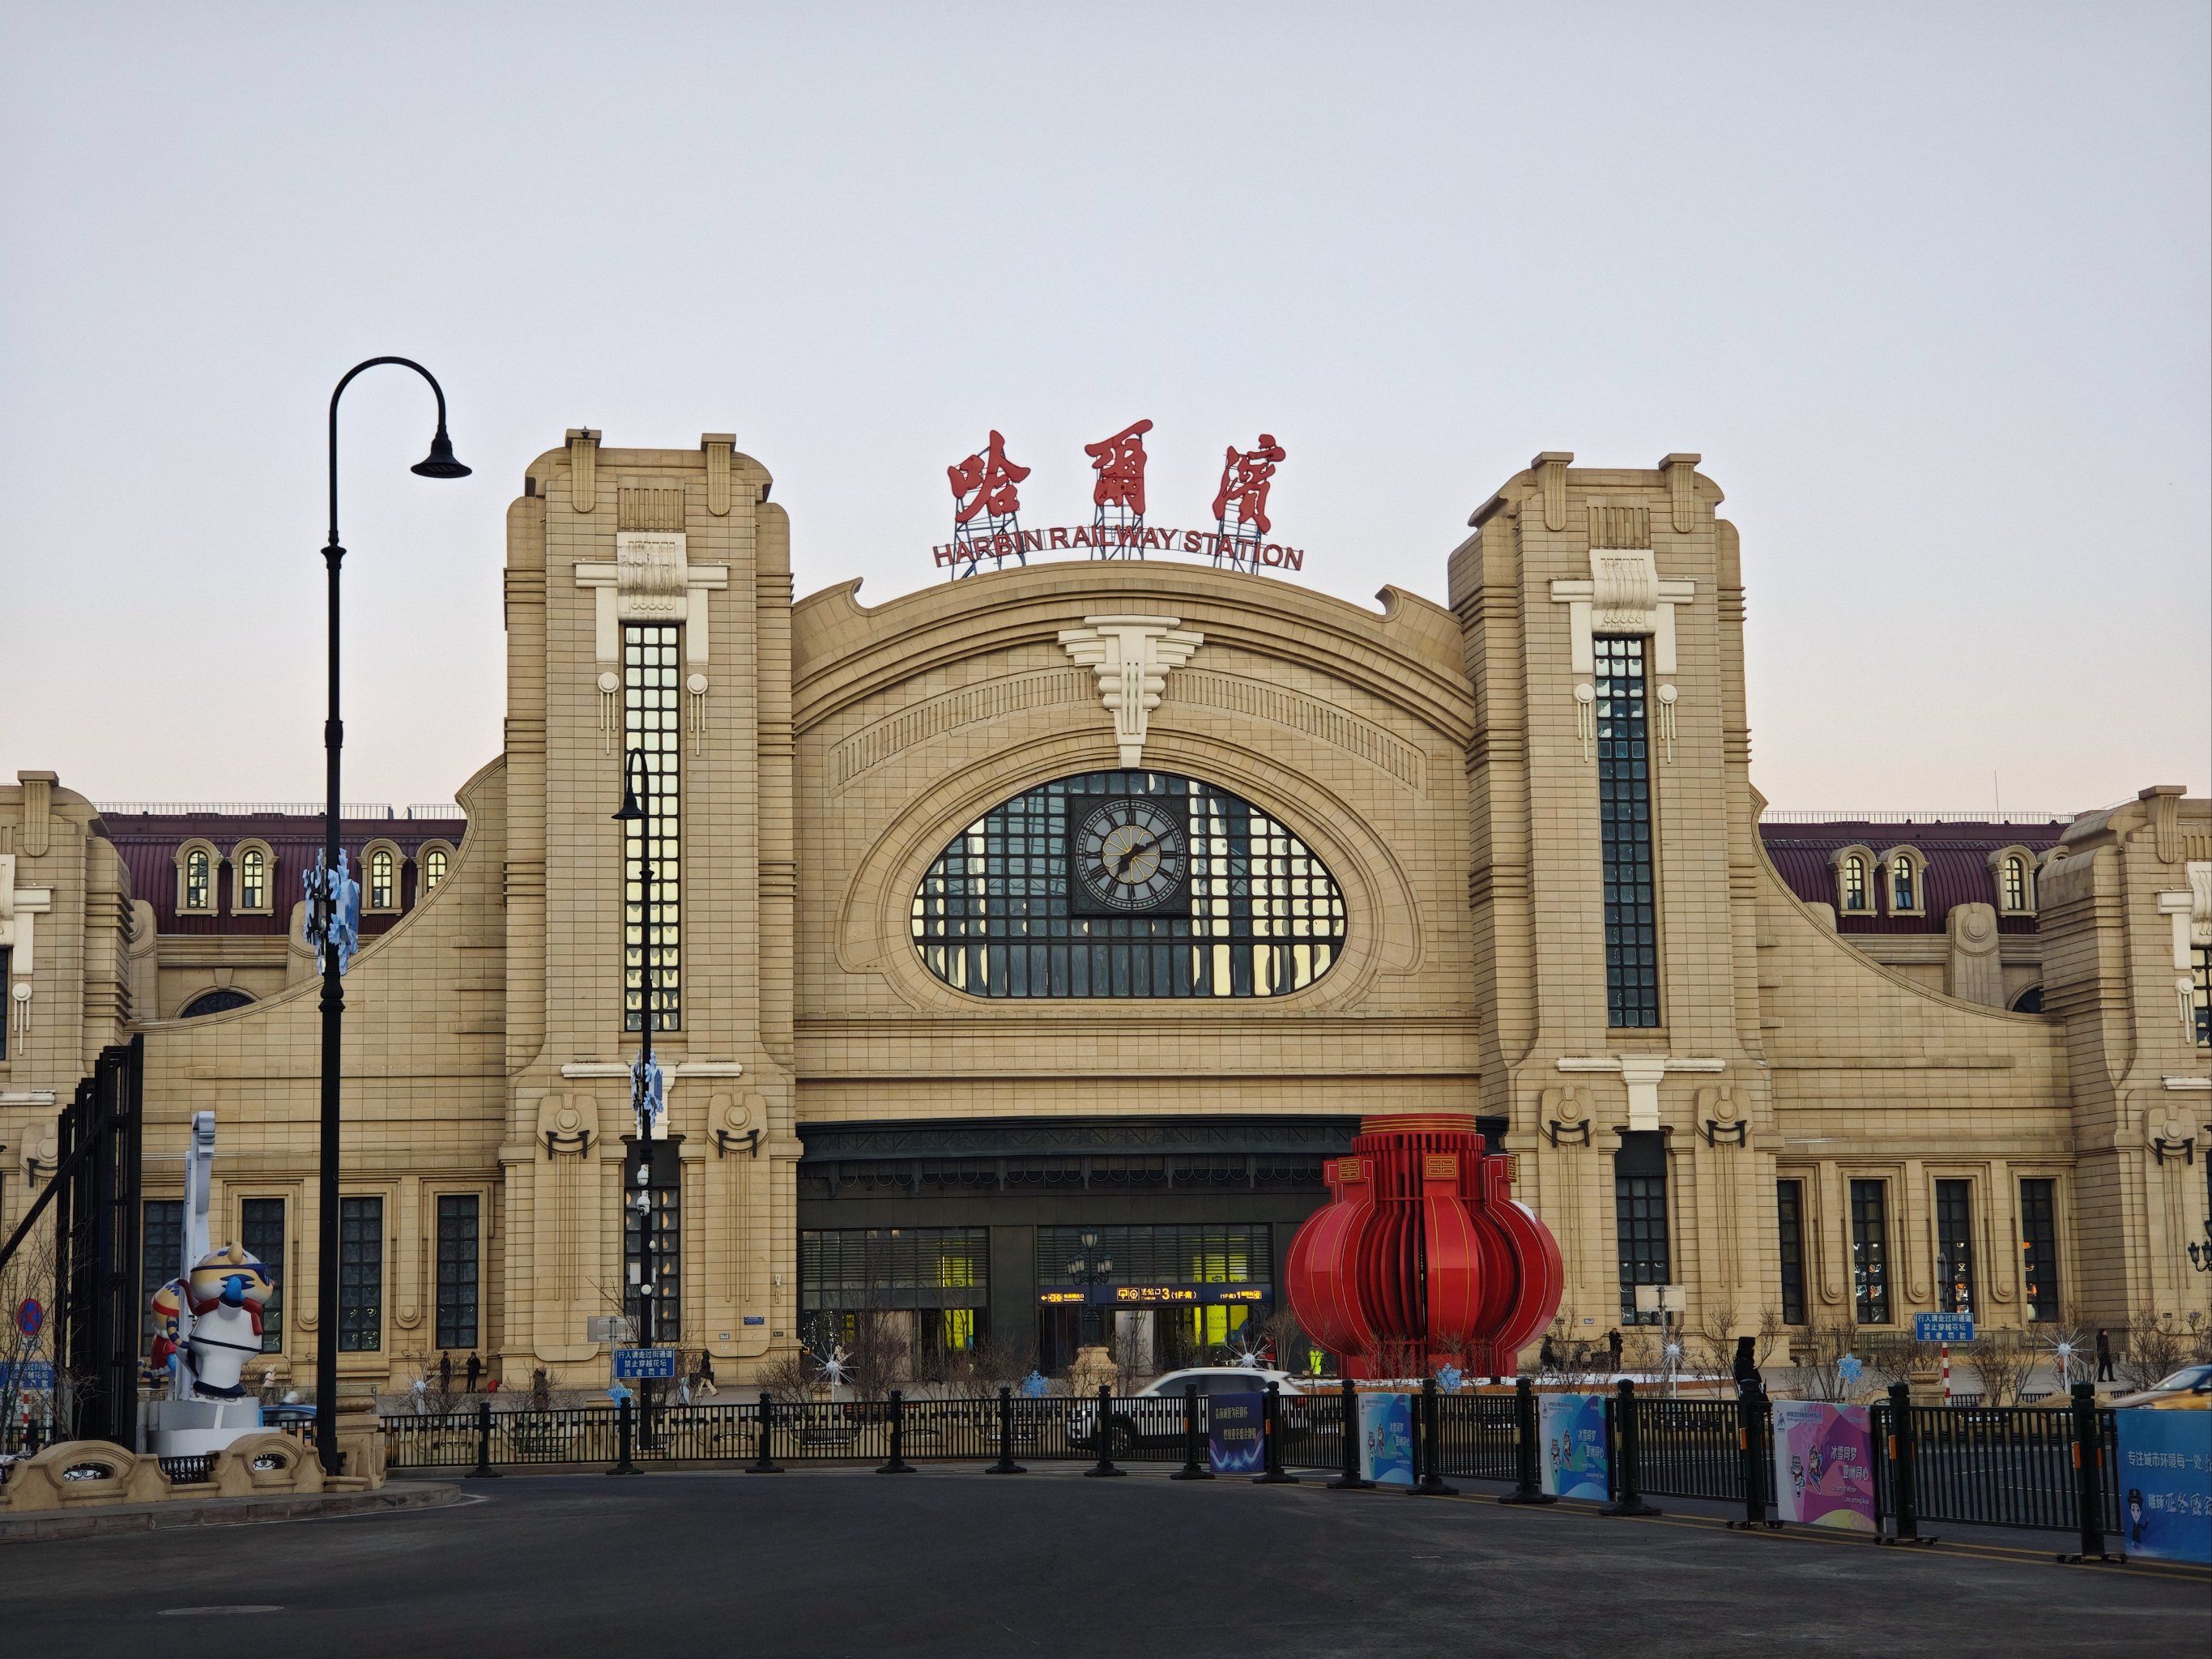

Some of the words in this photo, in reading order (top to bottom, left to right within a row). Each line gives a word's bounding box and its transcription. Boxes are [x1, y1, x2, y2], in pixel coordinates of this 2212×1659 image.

[932, 528, 1042, 567] HARBIN
[1048, 524, 1178, 552] RAILWAY
[1183, 529, 1304, 571] STATION
[1161, 1287, 1170, 1300] 3
[1918, 1315, 1971, 1323] 行人请走过街通道
[1924, 1323, 1967, 1331] 禁止穿越花坛
[618, 1350, 673, 1358] 行人请走过街通道
[624, 1359, 667, 1367] 禁止穿越花坛
[624, 1368, 667, 1376] 违者罚款
[1831, 1445, 1857, 1461] 冰雪同梦
[1843, 1465, 1869, 1481] 亚洲同心
